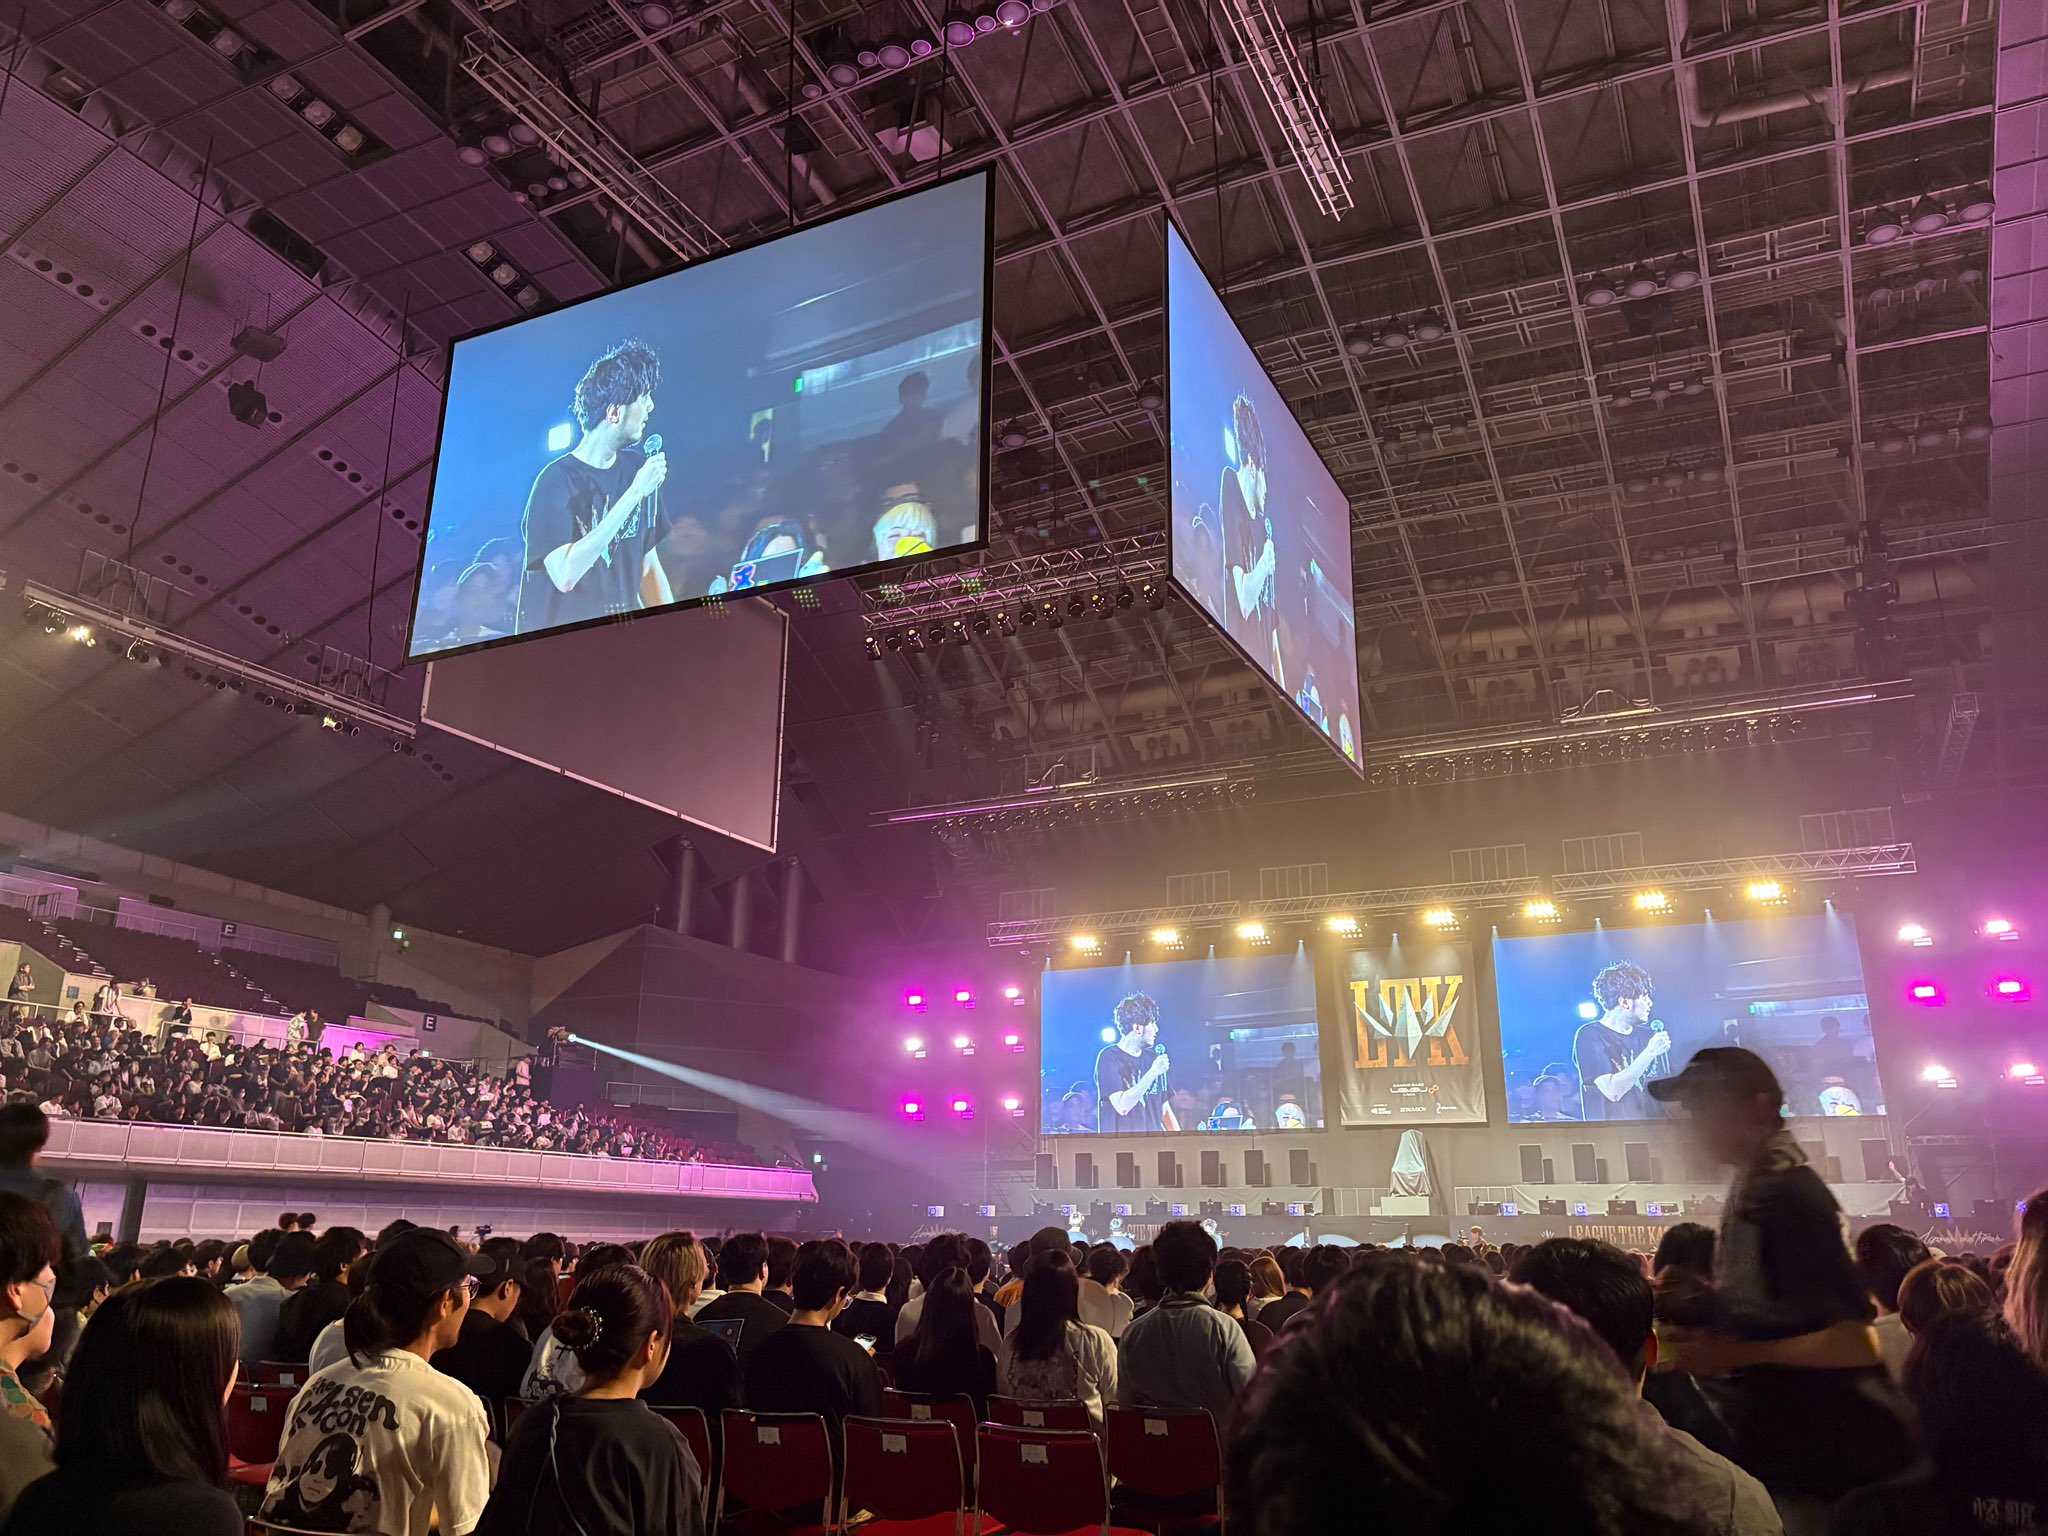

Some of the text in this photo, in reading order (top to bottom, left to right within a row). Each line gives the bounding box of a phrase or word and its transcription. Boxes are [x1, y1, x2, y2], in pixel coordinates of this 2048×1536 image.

[426, 1016, 434, 1029] E
[1349, 975, 1469, 1068] LTK
[1568, 1225, 1617, 1243] LEAGUE
[1618, 1225, 1646, 1245] THE
